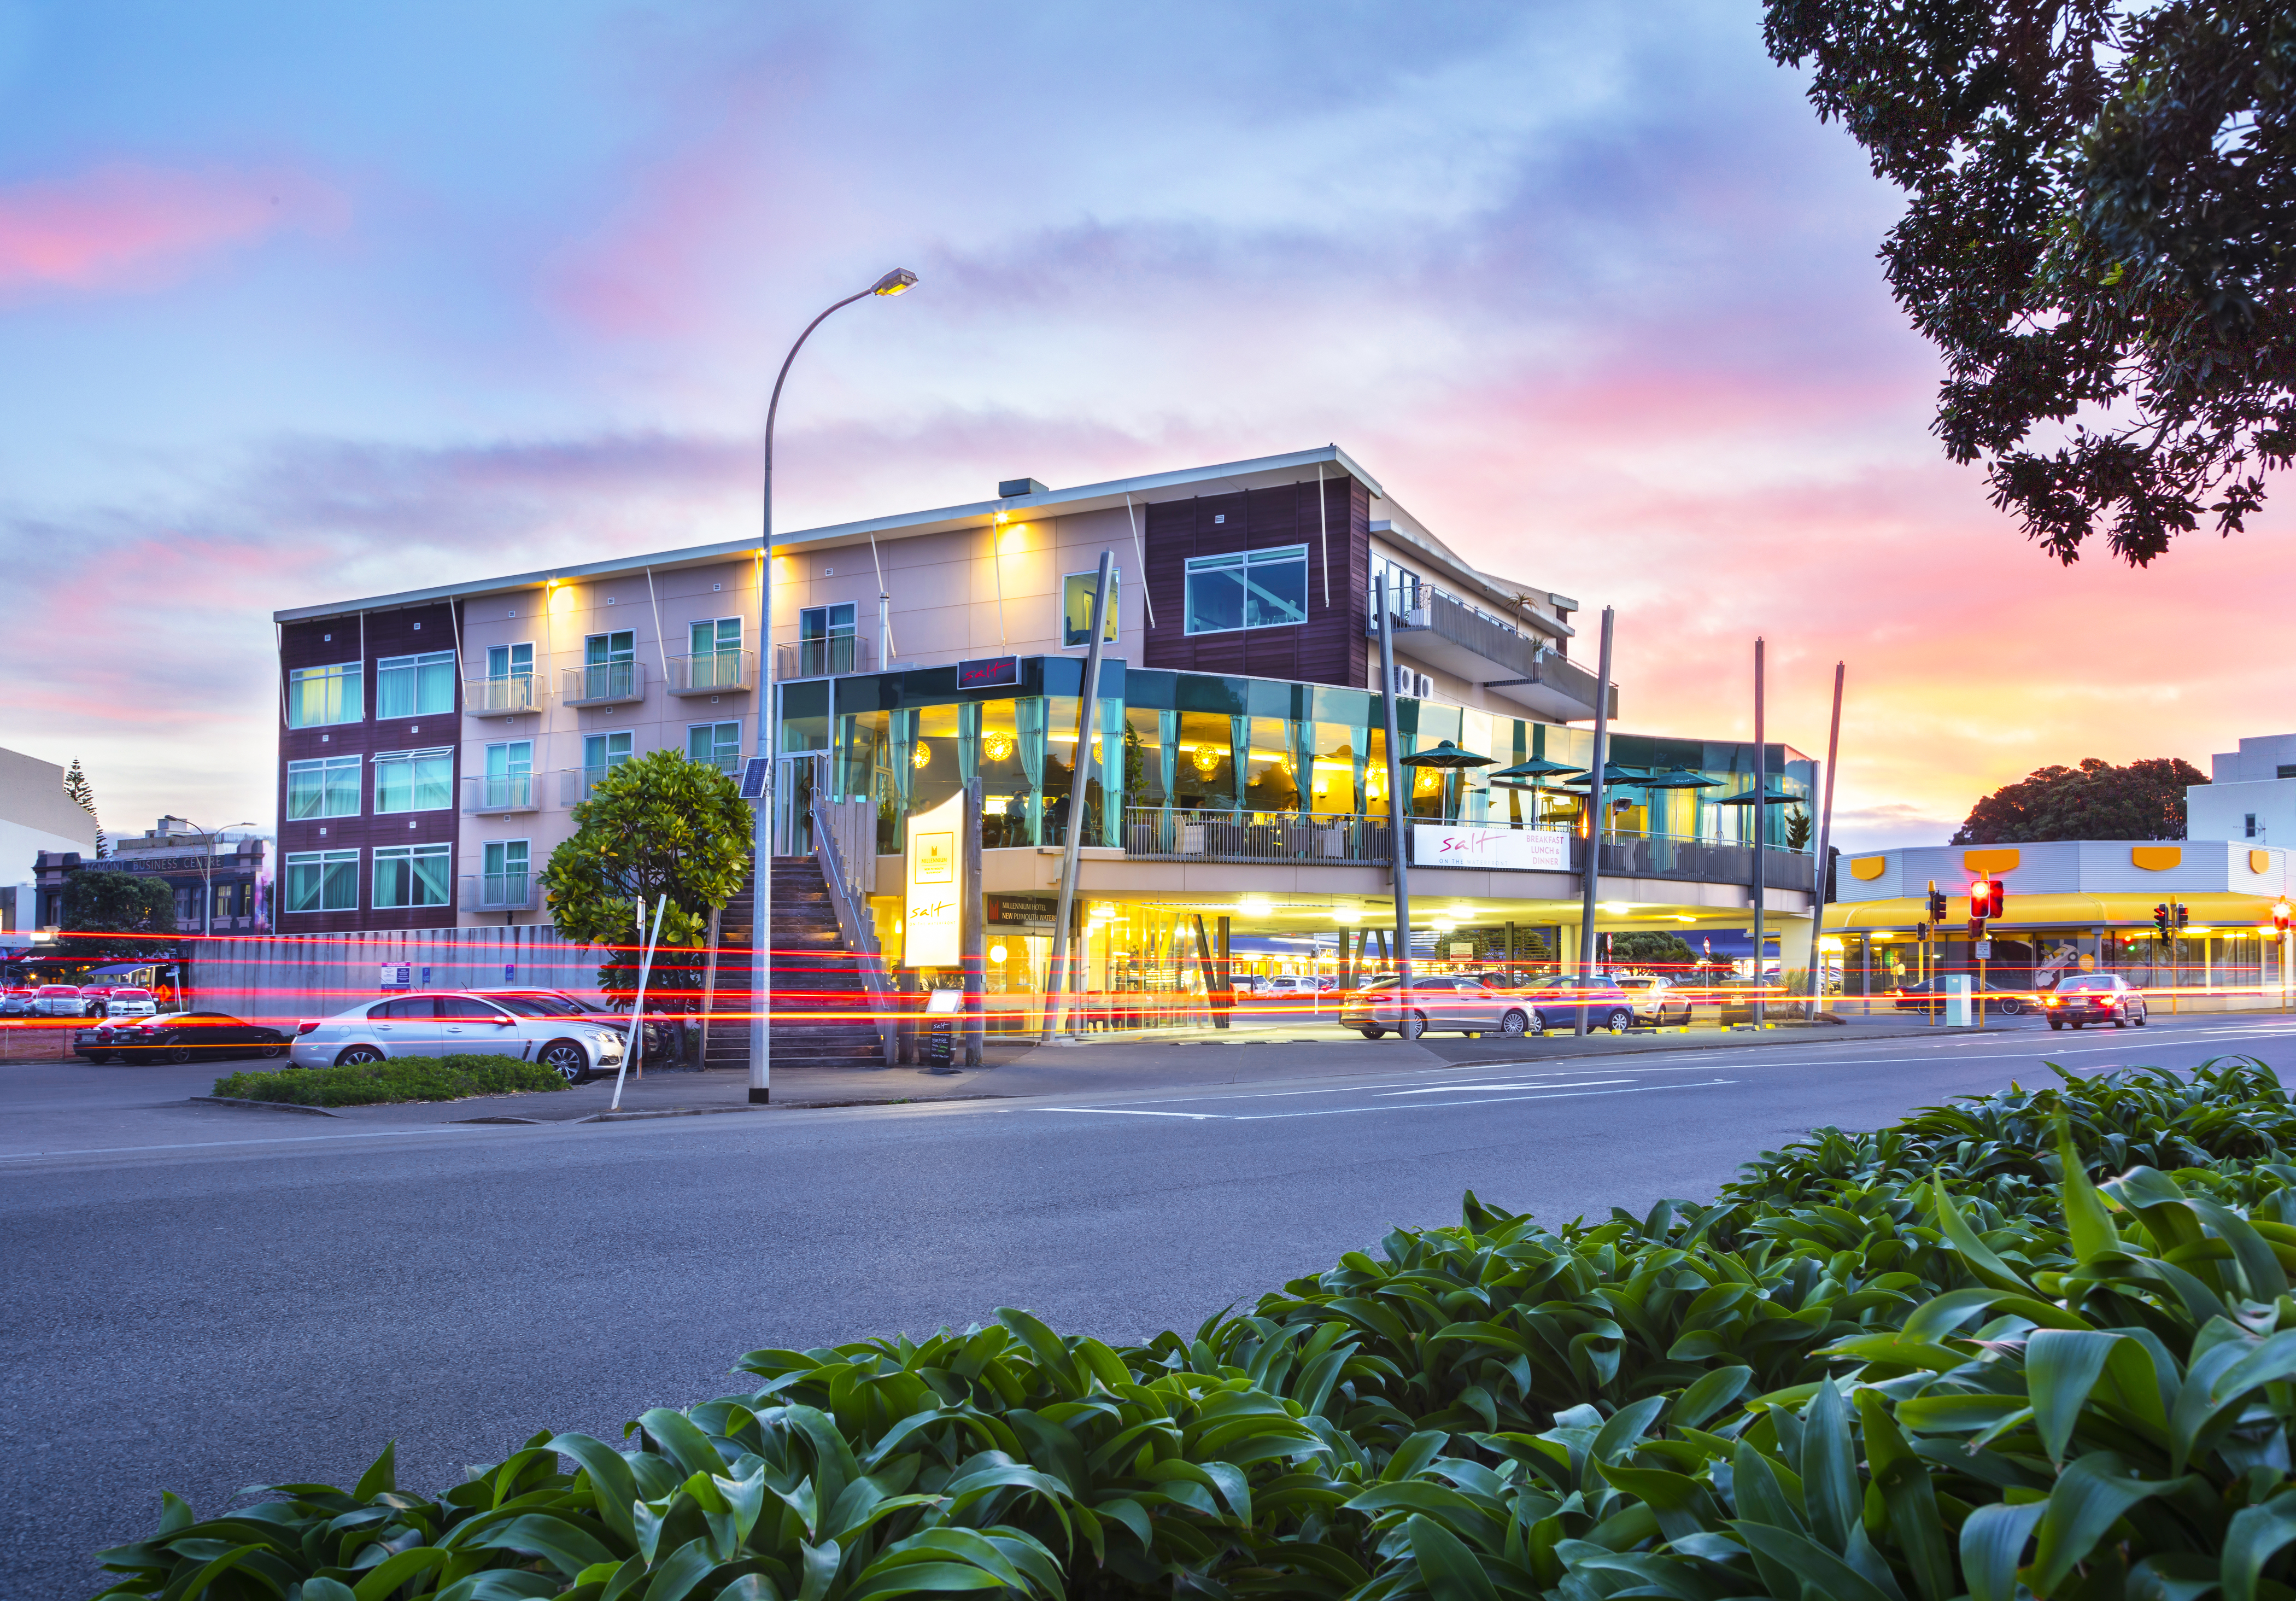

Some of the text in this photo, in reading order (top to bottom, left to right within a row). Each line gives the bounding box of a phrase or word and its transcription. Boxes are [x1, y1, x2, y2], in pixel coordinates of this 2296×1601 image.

[963, 662, 1015, 681] salt
[1439, 829, 1508, 854] salt
[1526, 835, 1564, 844] BREAKFAST
[1531, 846, 1554, 855] LUNCH
[133, 858, 177, 870] BUSINESS
[184, 856, 221, 868] CENTRE
[1532, 857, 1559, 866] DINNER
[910, 901, 956, 919] salt
[1002, 902, 1031, 910] MILLENNIUM
[1014, 913, 1038, 921] PLYMOUTH
